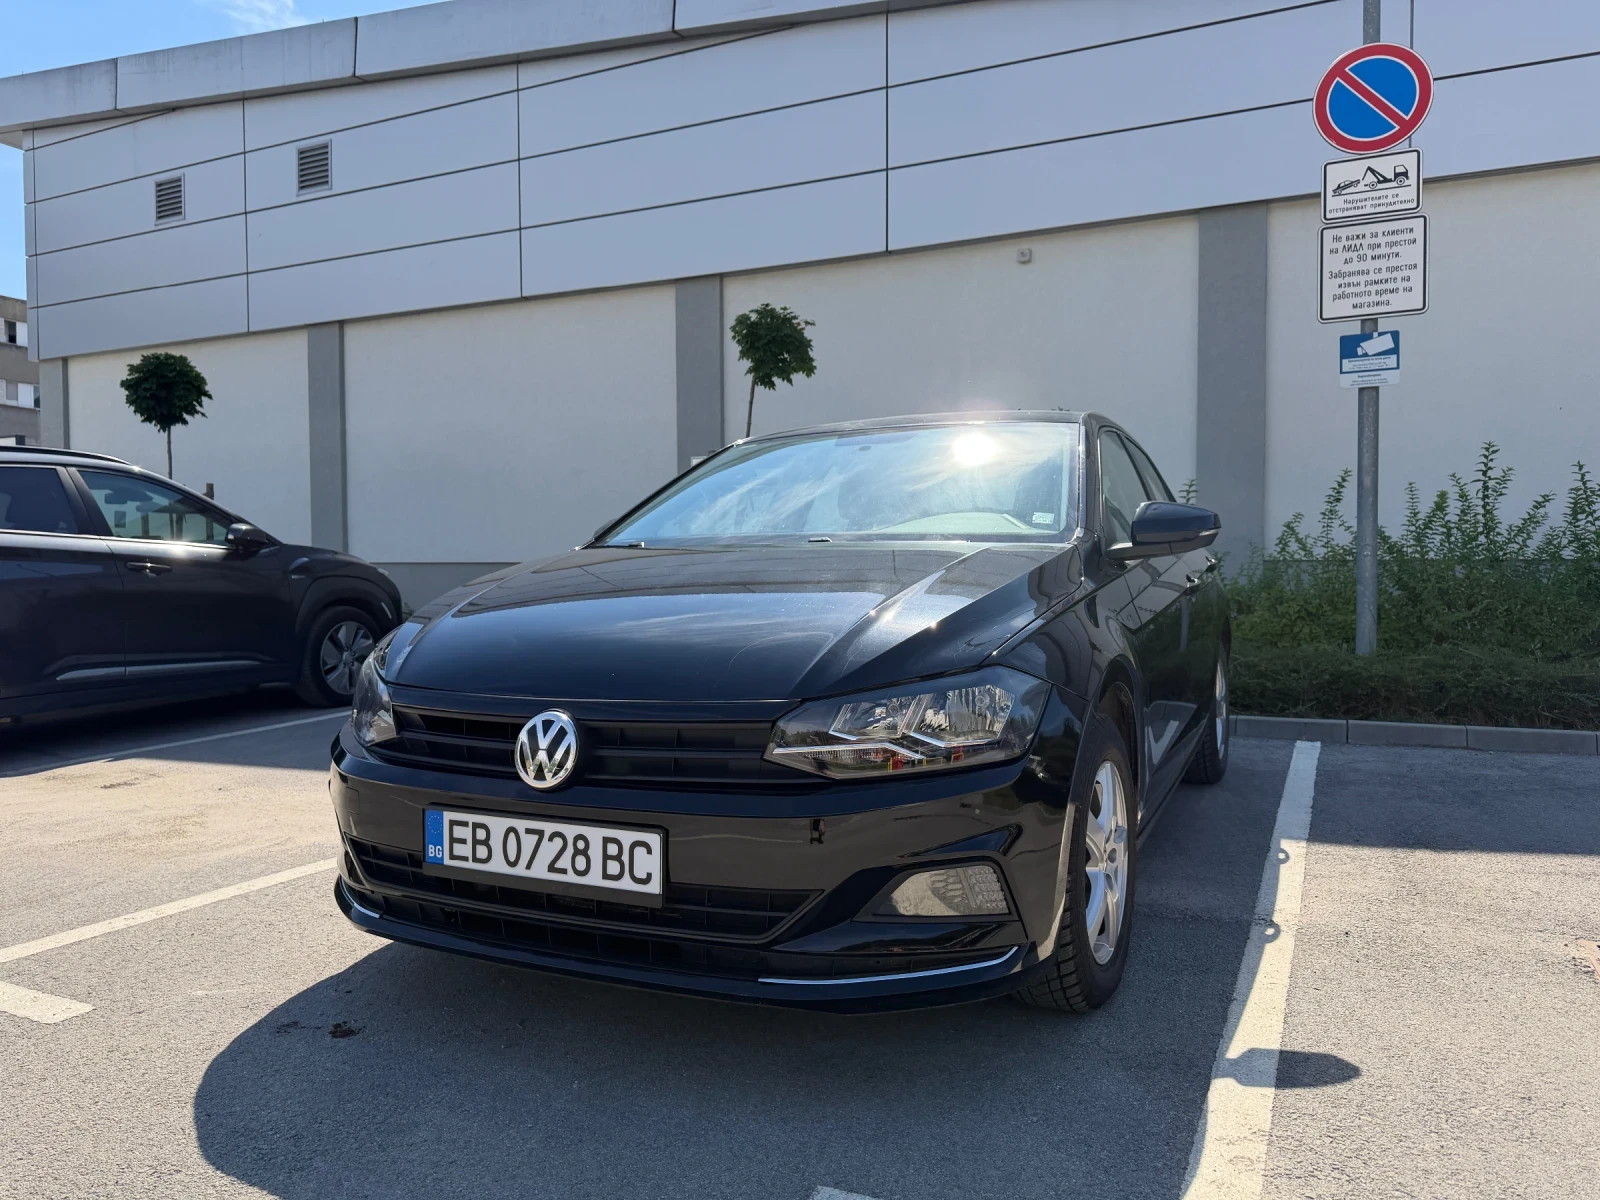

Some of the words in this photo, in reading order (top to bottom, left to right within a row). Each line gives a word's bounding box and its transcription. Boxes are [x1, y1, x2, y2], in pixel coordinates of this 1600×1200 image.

[1329, 205, 1367, 214] отстраняват
[1370, 198, 1414, 209] принудително
[1343, 194, 1389, 205] Нарушителите
[1332, 234, 1342, 243] Не
[1346, 232, 1366, 241] важи
[1382, 227, 1414, 237] клиенти
[1342, 242, 1364, 254] ЛИДЛ
[1367, 242, 1381, 251] при
[1385, 237, 1416, 248] престой
[1357, 253, 1367, 262] 90
[1371, 251, 1402, 261] минути.
[1328, 269, 1370, 280] Забранява
[1386, 263, 1417, 273] престоя
[1338, 280, 1361, 289] извън
[1364, 276, 1397, 288] рамките
[1332, 290, 1371, 302] работното
[1375, 287, 1399, 297] време
[1352, 299, 1392, 309] магазина.
[429, 844, 442, 858] BG
[448, 819, 492, 864] EB
[502, 825, 591, 877] 0728
[602, 836, 653, 885] BC
